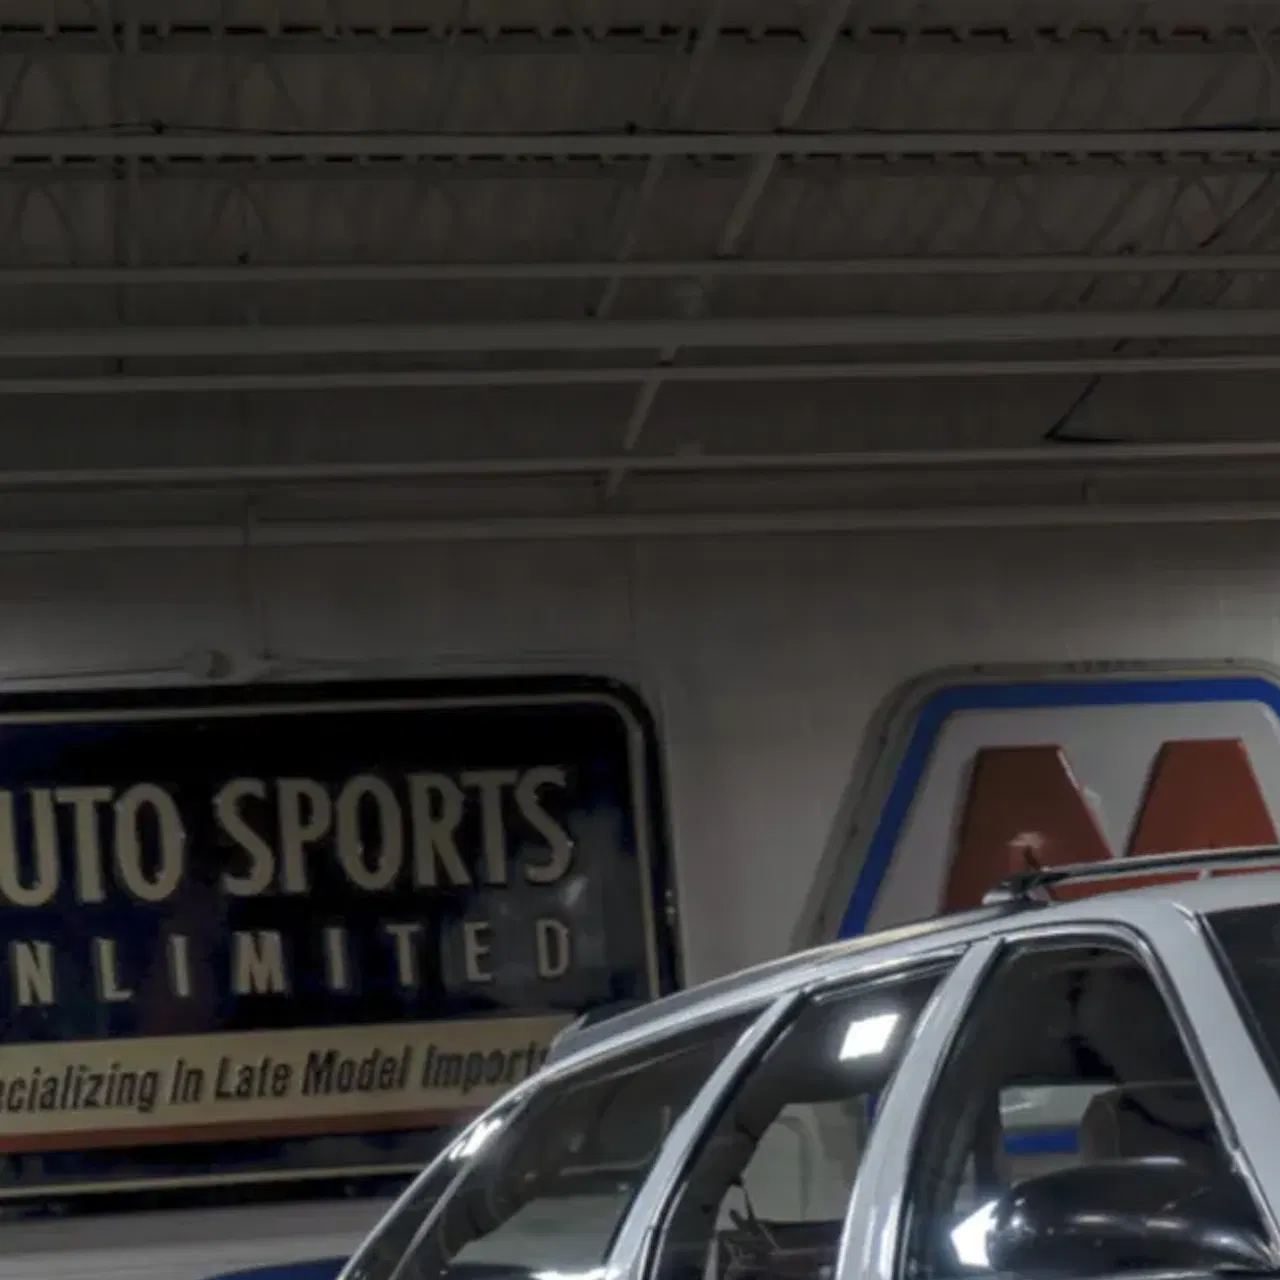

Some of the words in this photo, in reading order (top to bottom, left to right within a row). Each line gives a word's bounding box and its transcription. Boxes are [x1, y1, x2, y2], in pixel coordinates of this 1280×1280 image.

[214, 765, 576, 896] SPORTS
[12, 917, 573, 1007] NLIMITED
[0, 1063, 159, 1114] cializing
[170, 1058, 204, 1104] In
[214, 1054, 292, 1099] Late
[301, 1049, 407, 1096] Model
